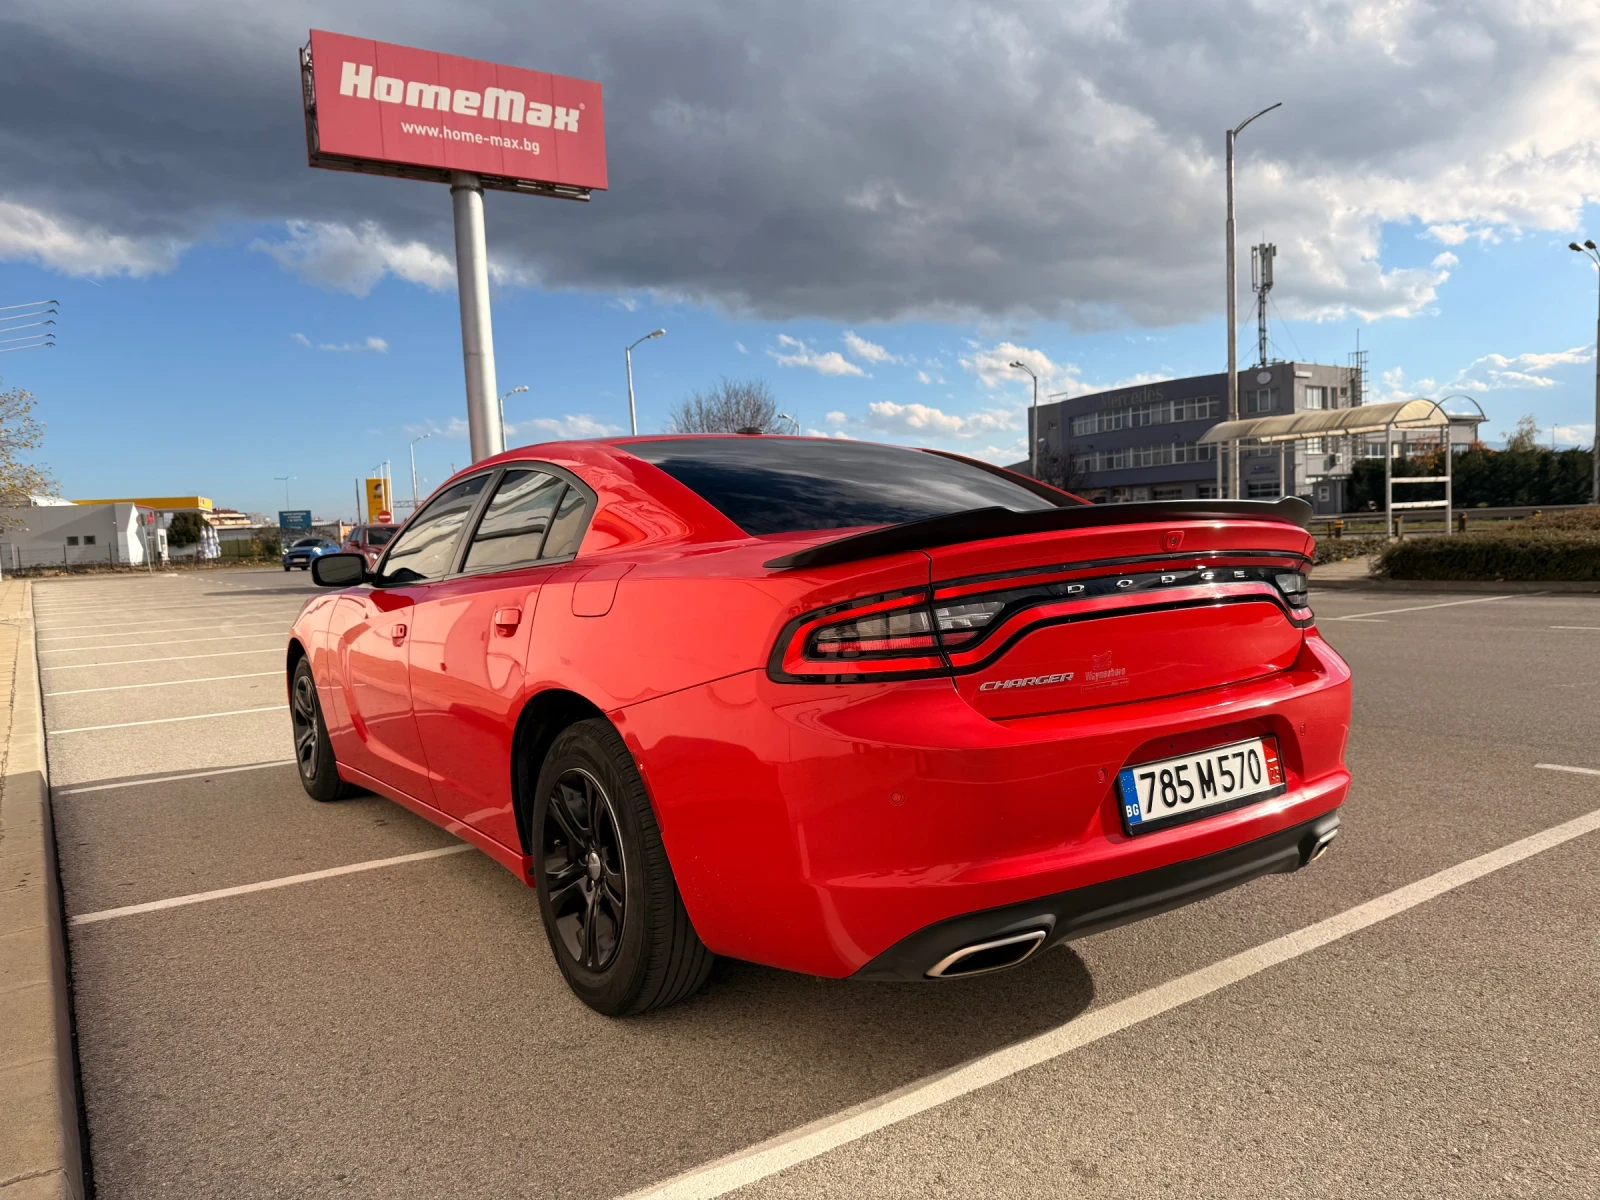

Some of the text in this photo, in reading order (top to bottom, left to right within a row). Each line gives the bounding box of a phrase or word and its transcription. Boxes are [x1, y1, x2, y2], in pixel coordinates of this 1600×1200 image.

[339, 61, 580, 133] HomeMax
[400, 121, 540, 155] www.home-max.bg
[1100, 385, 1164, 408] Mercedes
[1067, 570, 1246, 594] DODGE
[979, 672, 1075, 691] CHARGER
[1125, 804, 1140, 818] BG
